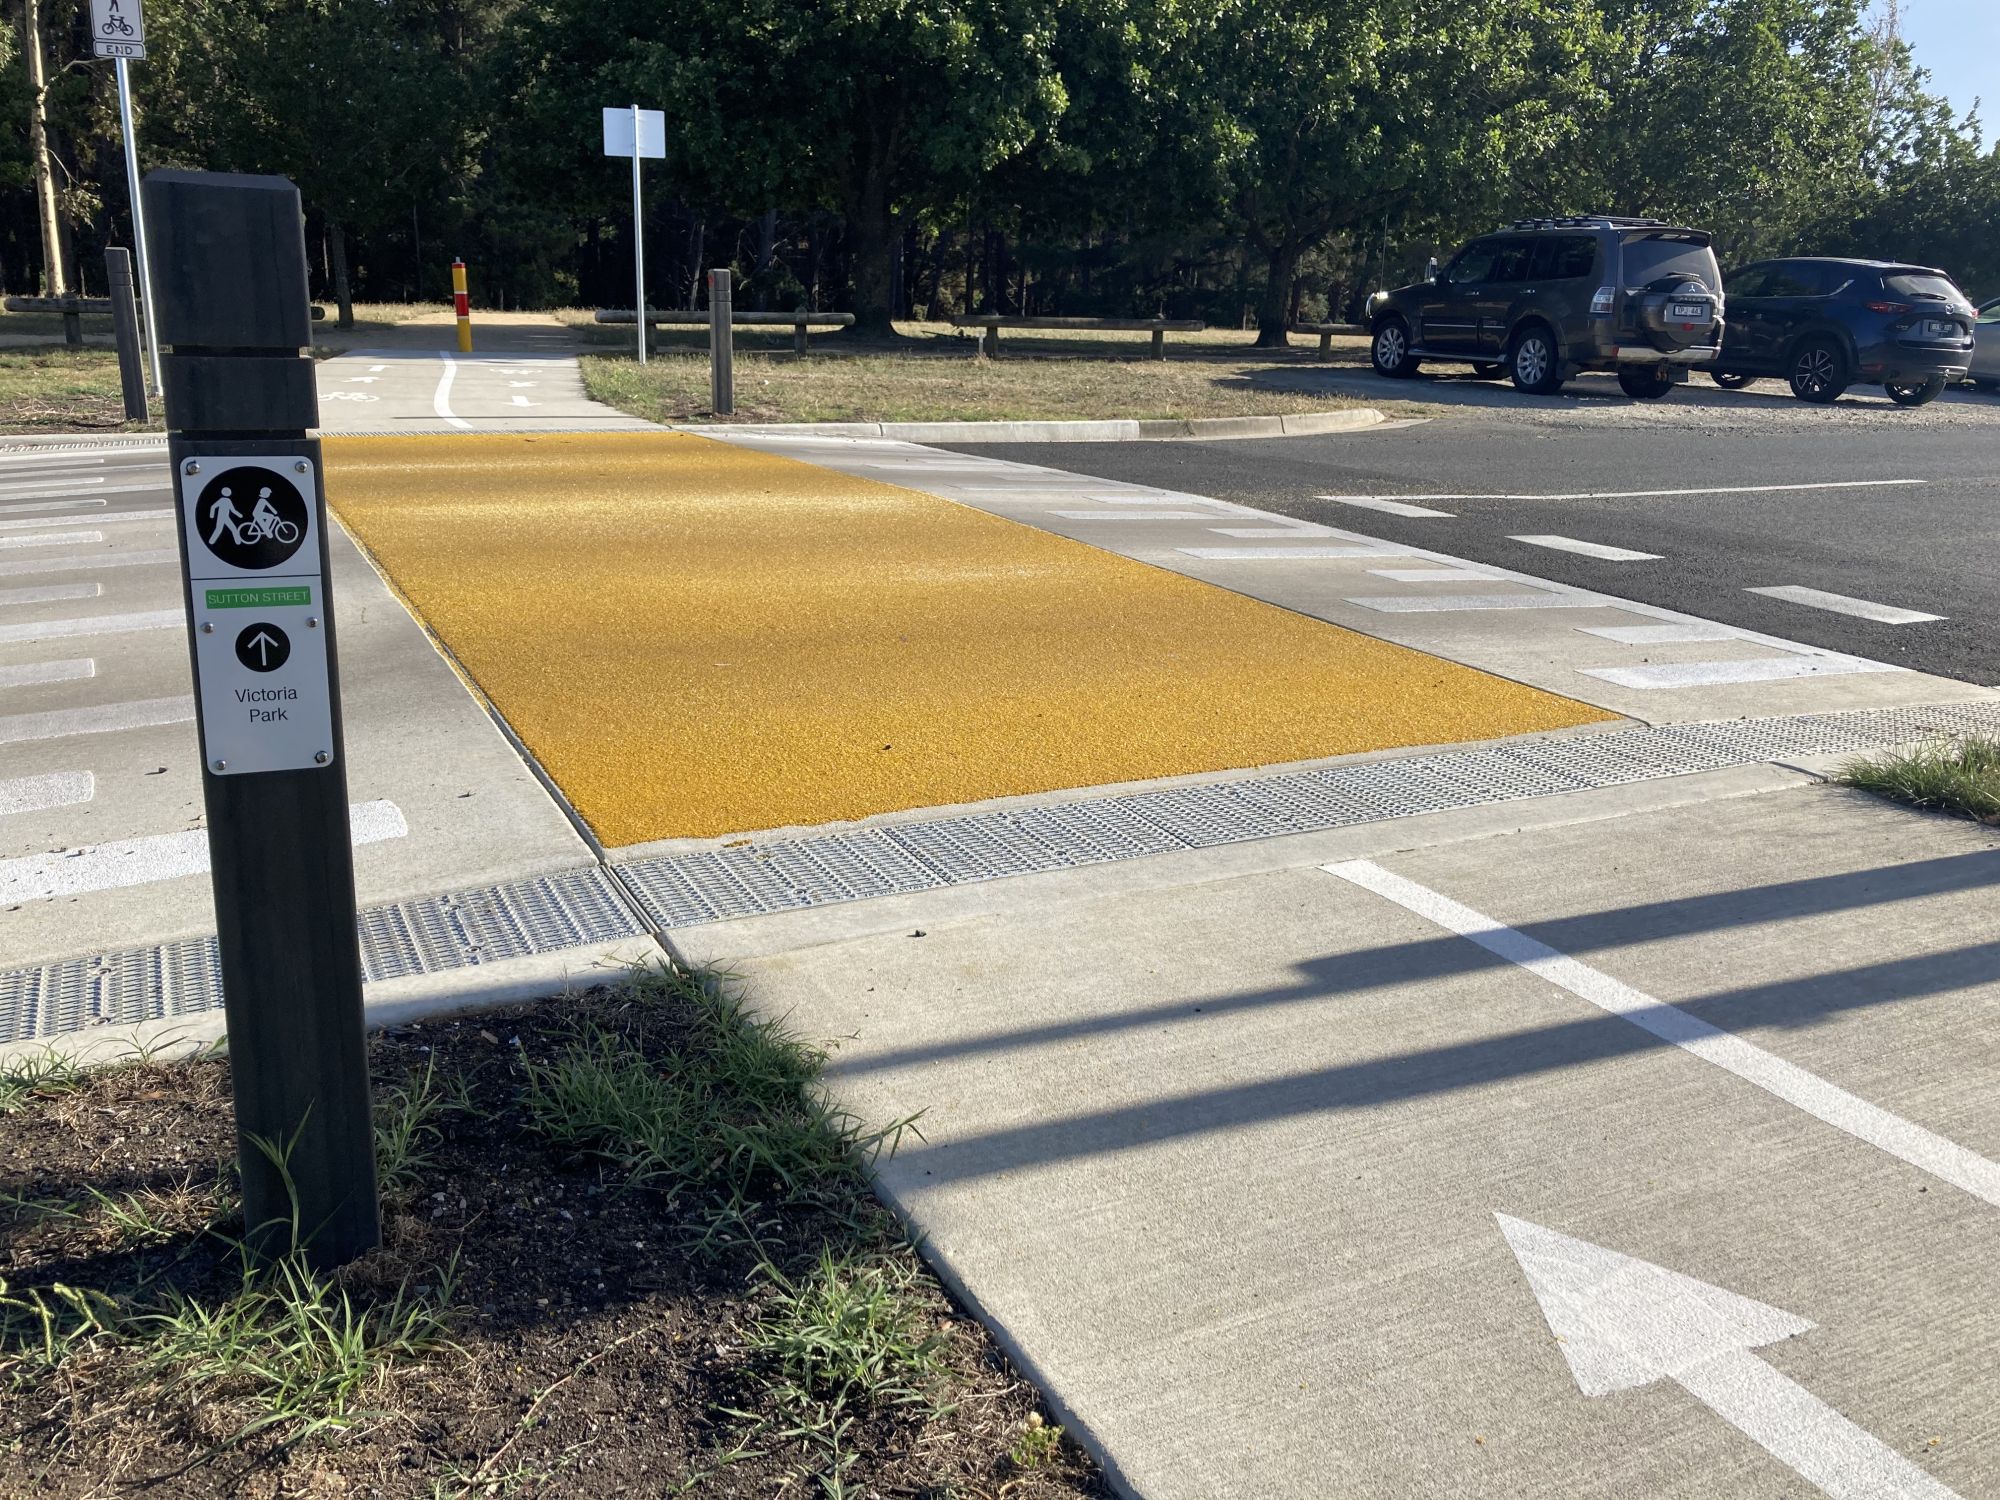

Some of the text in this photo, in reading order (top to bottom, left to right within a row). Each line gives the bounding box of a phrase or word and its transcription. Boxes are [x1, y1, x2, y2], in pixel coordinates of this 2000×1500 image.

[106, 45, 133, 55] END
[208, 590, 308, 605] SUTTON STREET
[234, 686, 297, 703] Victoria
[249, 708, 288, 723] Park
